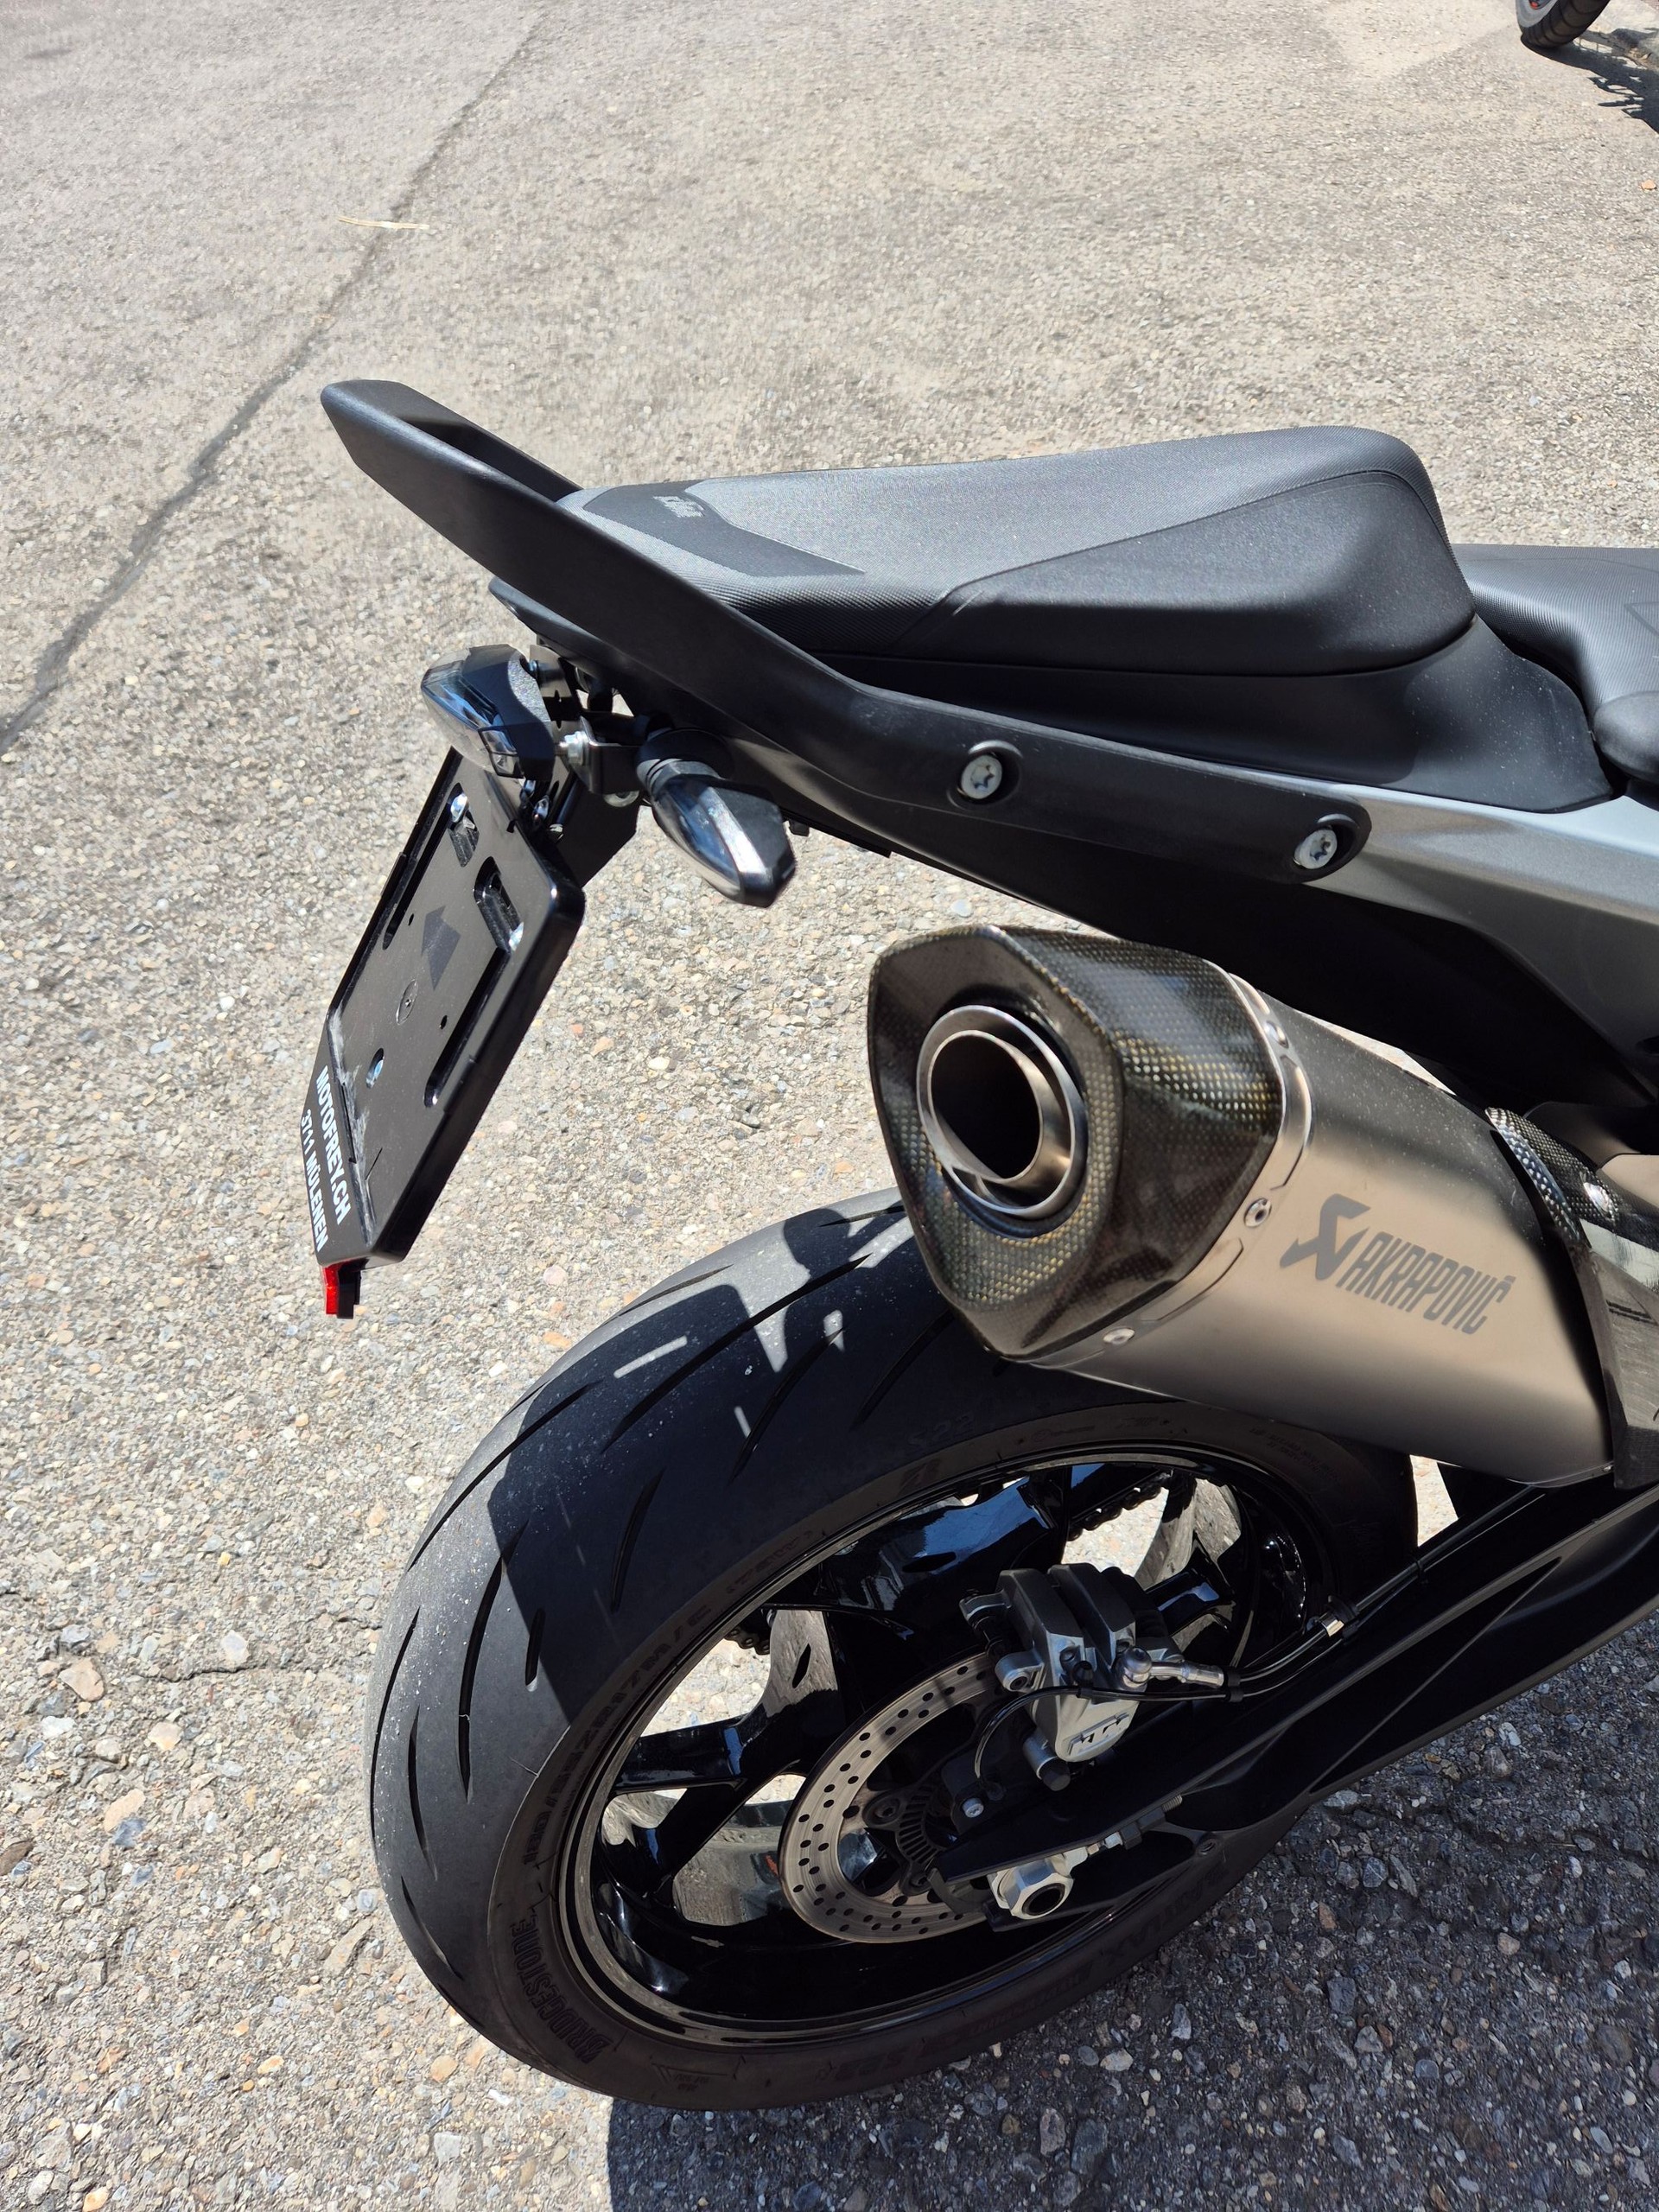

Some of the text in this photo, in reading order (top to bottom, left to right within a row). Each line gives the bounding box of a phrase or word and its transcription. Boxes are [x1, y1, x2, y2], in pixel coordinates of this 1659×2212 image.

[301, 1108, 315, 1155] 3711
[316, 1065, 352, 1225] MOTOFREY.CH
[510, 1912, 614, 2064] BRIDGESTONE
